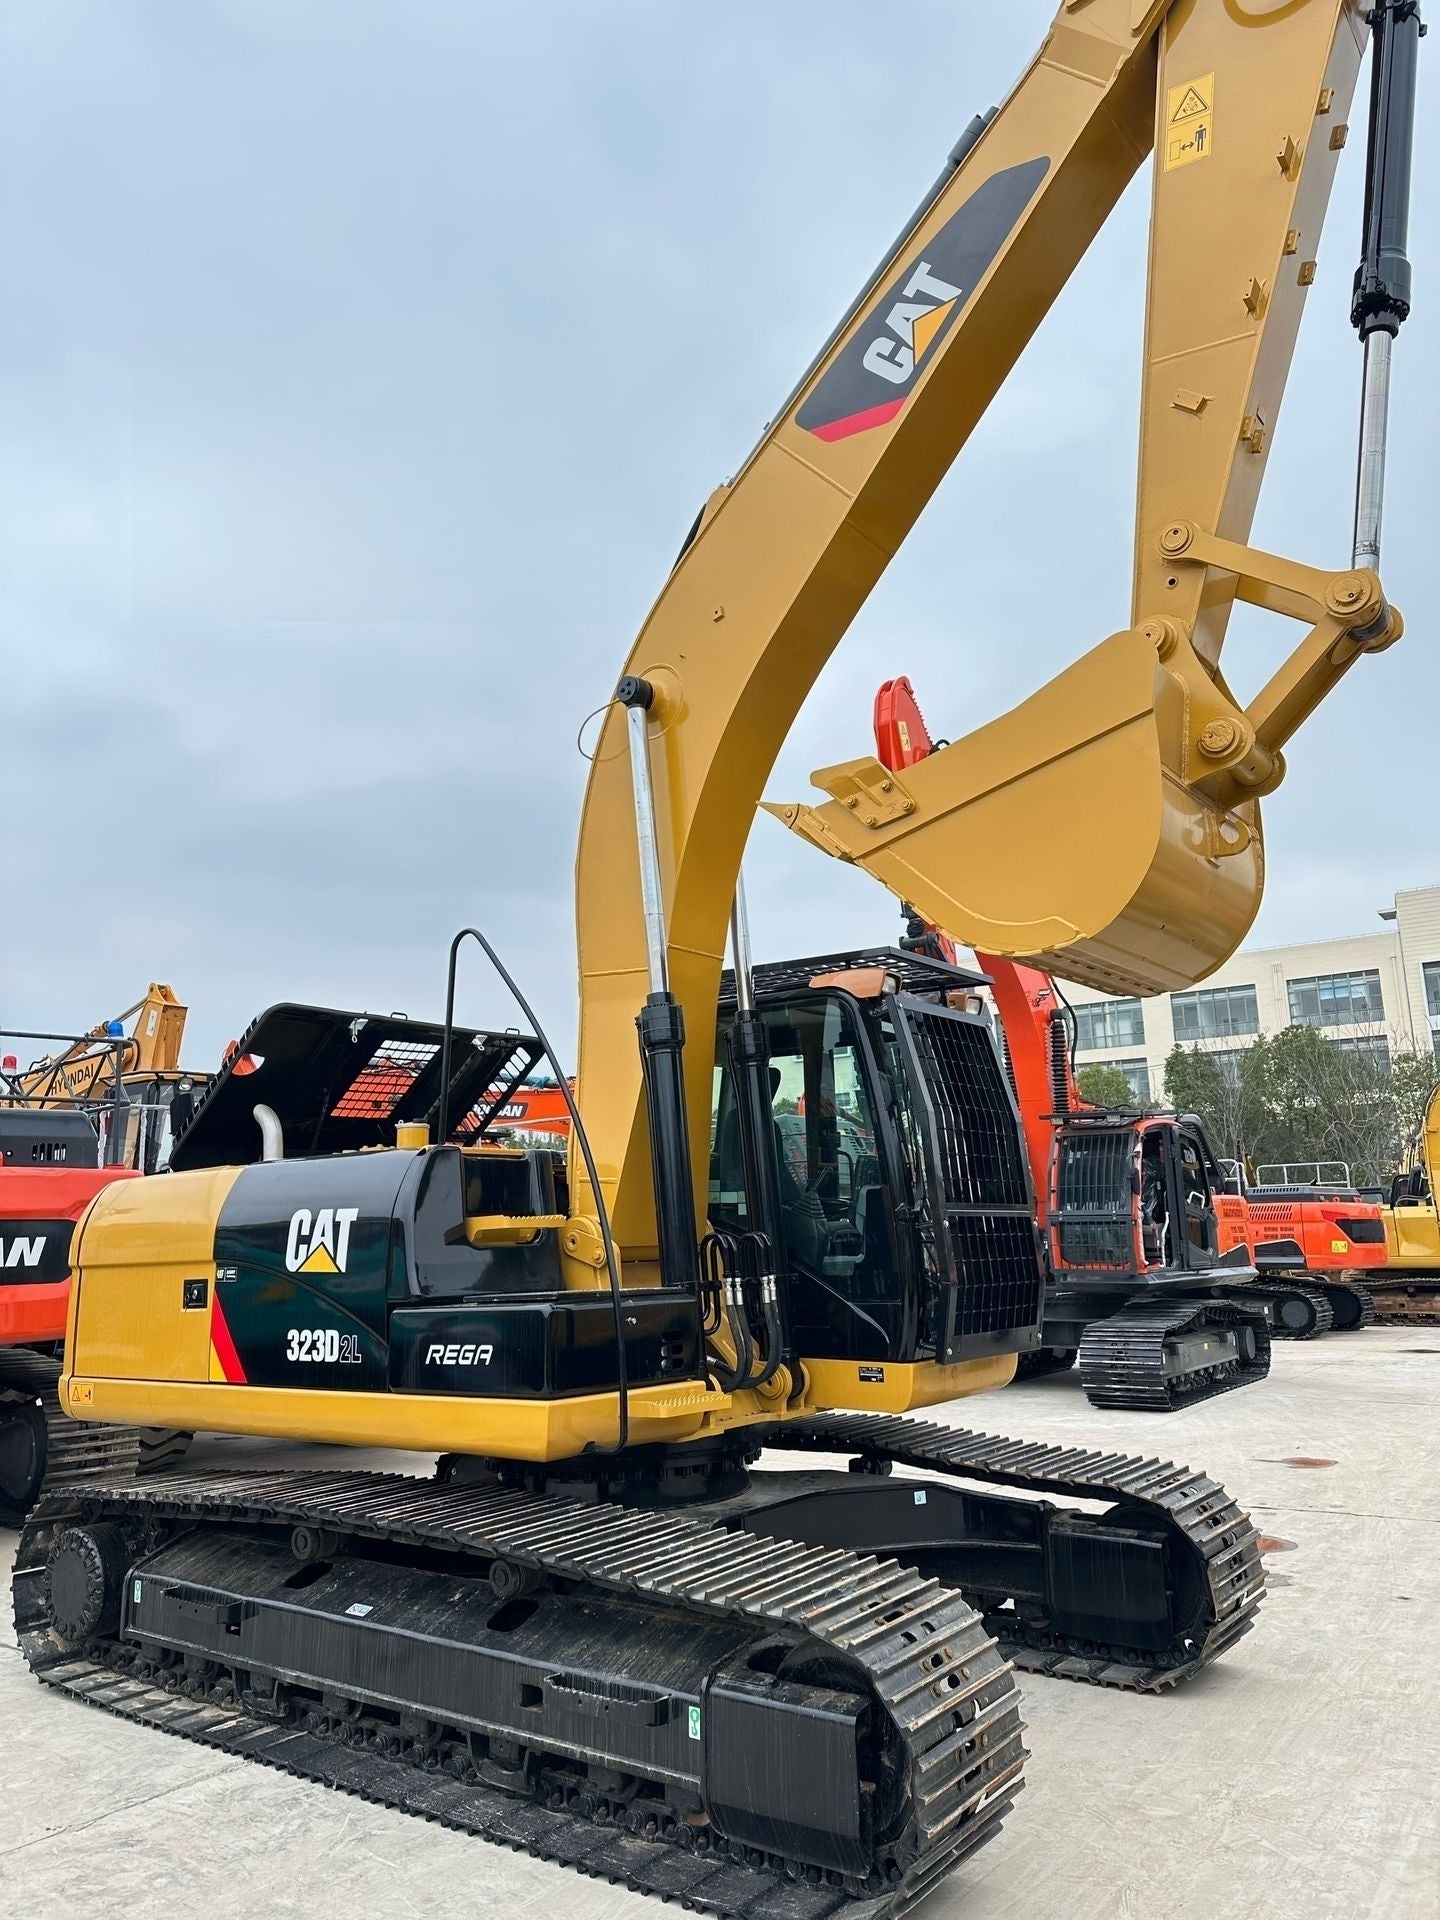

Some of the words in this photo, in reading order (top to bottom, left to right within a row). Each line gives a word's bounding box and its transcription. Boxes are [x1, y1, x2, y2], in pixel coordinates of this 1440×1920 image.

[863, 261, 963, 384] CAT
[285, 1208, 359, 1272] CAT
[425, 1344, 493, 1366] REGA
